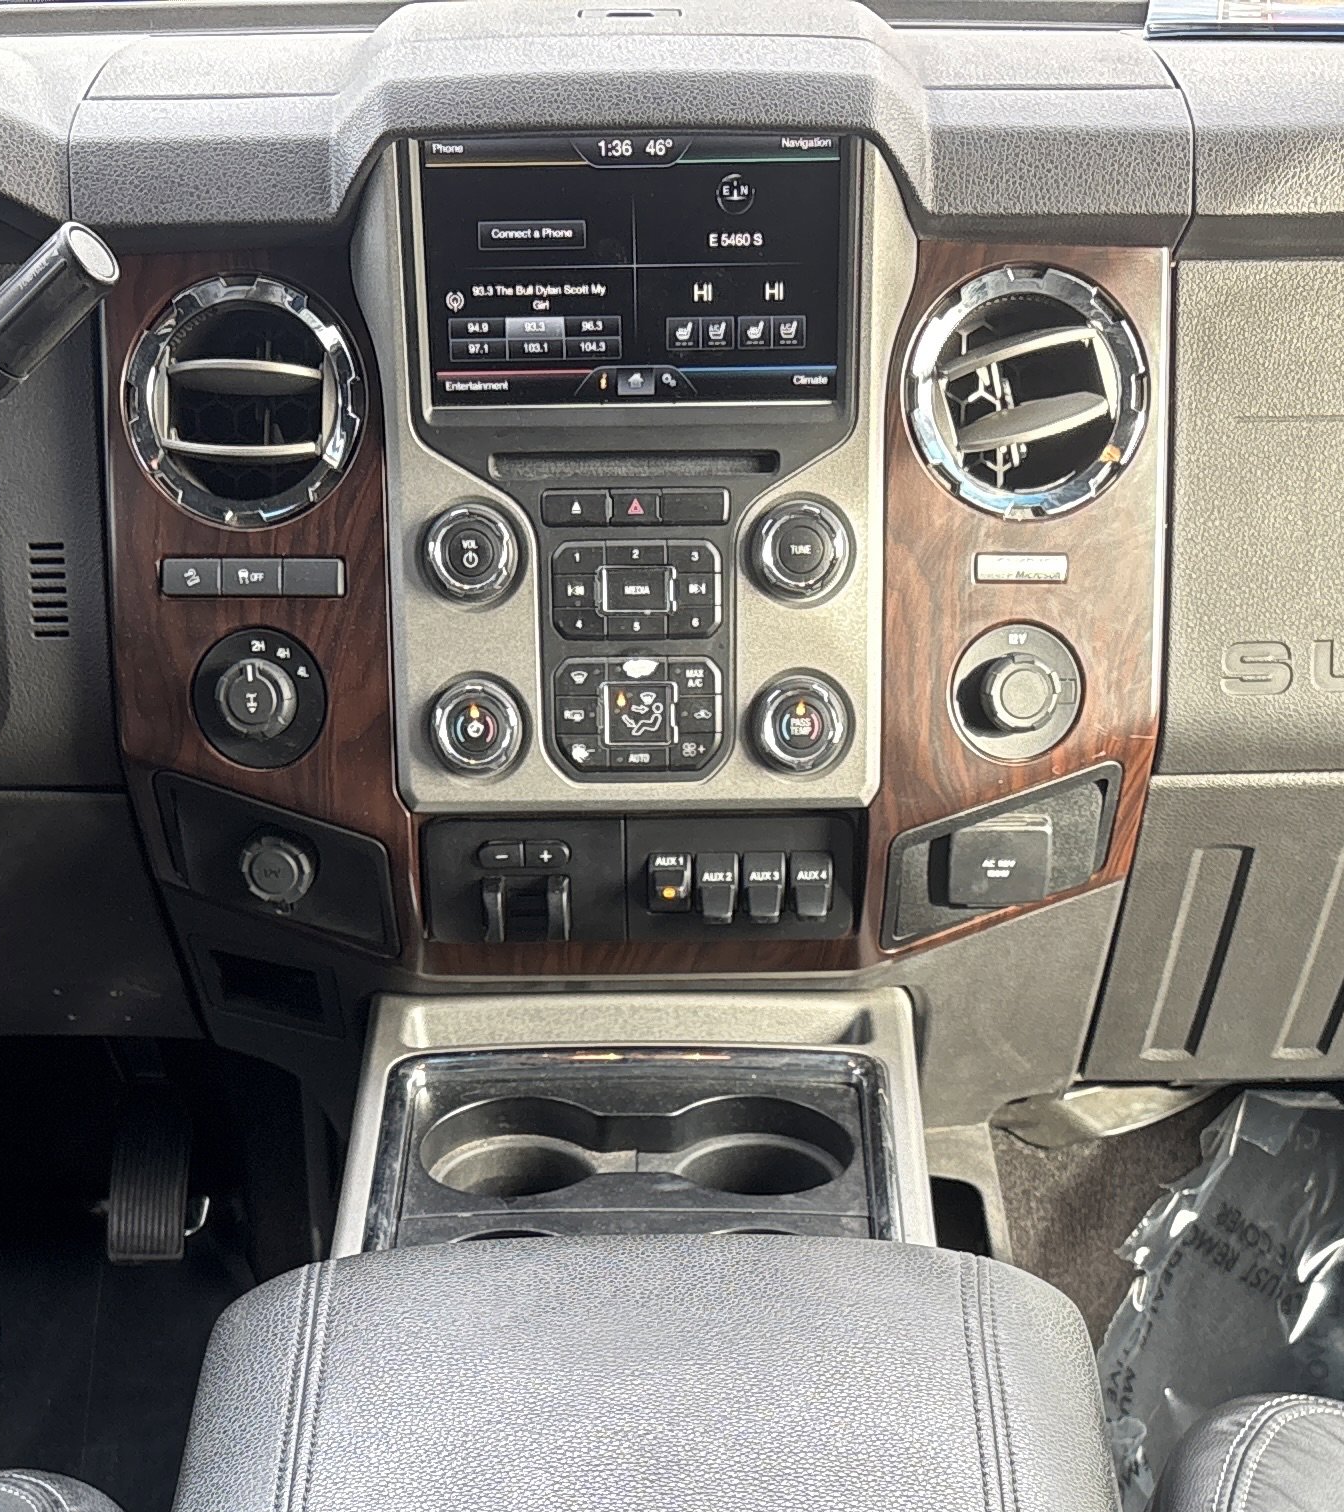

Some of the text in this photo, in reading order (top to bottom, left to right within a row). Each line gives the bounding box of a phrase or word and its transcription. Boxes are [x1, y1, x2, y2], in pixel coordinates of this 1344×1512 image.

[431, 142, 464, 155] Phone
[597, 139, 674, 157] 1:36 46°
[781, 136, 833, 150] Navigation
[491, 227, 532, 240] Connect
[542, 226, 573, 239] Phone
[709, 232, 763, 247] E 5460 S
[496, 285, 514, 296] The
[516, 285, 534, 295] Bull
[536, 284, 562, 298] Dylan
[563, 284, 589, 295] Scott
[591, 283, 607, 297] My
[692, 281, 713, 302] HI
[765, 280, 784, 301] HI
[532, 299, 550, 311] Girl
[468, 341, 606, 354] 97.1 103.1 104.3
[792, 374, 829, 386] Climate
[445, 380, 509, 392] Entertainment
[461, 539, 478, 550] VOL
[789, 544, 812, 555] TUNE
[573, 552, 580, 563] 1
[631, 548, 640, 559] 2
[690, 551, 699, 562] 3
[249, 571, 264, 582] OFF
[624, 585, 651, 595] MEDIA
[575, 619, 583, 630] 4
[632, 621, 640, 632] 5
[691, 617, 699, 628] 6
[250, 639, 266, 652] 2H
[276, 647, 291, 659] 4H
[685, 668, 704, 678] MAX
[628, 753, 651, 764] AUTO
[654, 856, 684, 866] AUX 1
[702, 871, 733, 882] AUX 2
[749, 870, 780, 881] AUX 3
[796, 870, 827, 881] AUX 4
